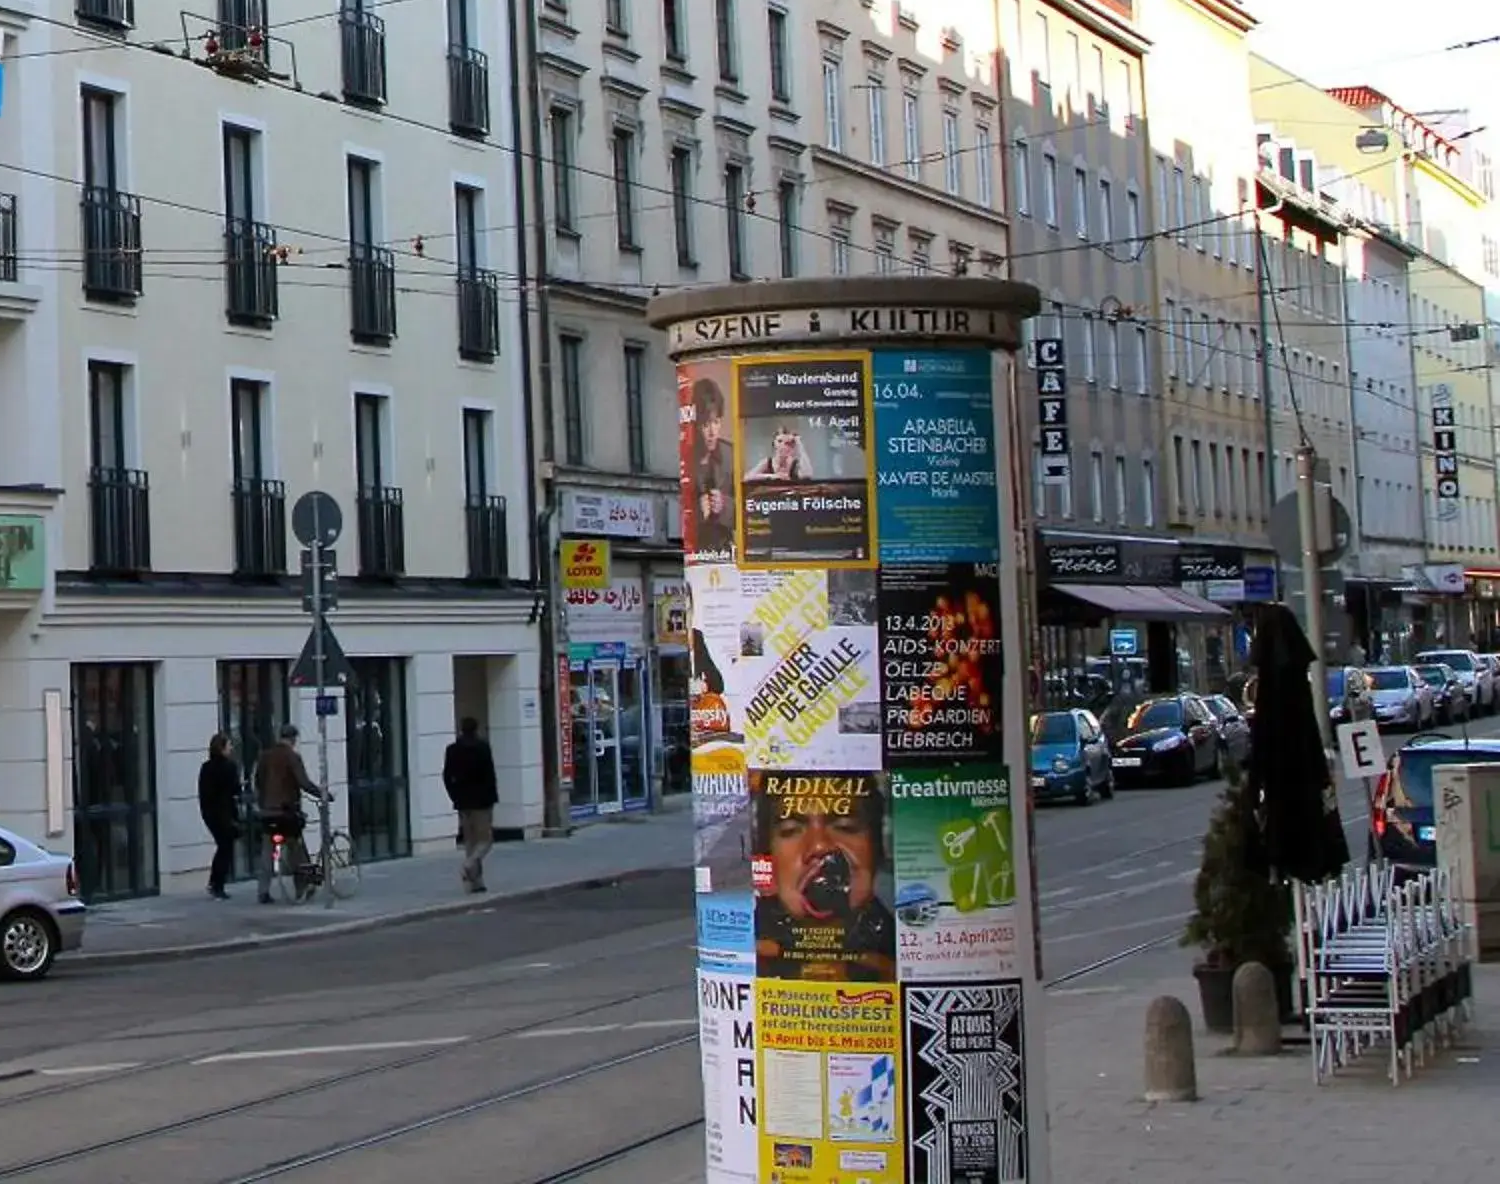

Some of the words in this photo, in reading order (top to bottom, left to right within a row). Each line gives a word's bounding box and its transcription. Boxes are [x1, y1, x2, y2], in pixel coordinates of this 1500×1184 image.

[851, 308, 971, 335] KULTUR
[873, 383, 924, 399] 16.04.
[828, 416, 860, 430] April
[903, 418, 977, 436] ARABELLA
[887, 437, 987, 454] STEINBACHER
[1434, 409, 1458, 496] KINO
[877, 471, 929, 486] XAVIER
[931, 471, 949, 486] DE
[746, 498, 799, 515] Evgenia
[803, 496, 861, 512] Fölsche
[566, 567, 603, 577] LOTTO
[885, 615, 956, 632] 13.4.2013
[883, 638, 1001, 656] AIDS-KONZERT
[885, 661, 947, 678] OELZE
[744, 641, 821, 727] ADENAUER
[777, 689, 807, 723] DE
[798, 636, 862, 702] GAULLE
[887, 730, 974, 749] LIEBREICH
[1351, 730, 1374, 769] E
[766, 777, 871, 796] RADIKAL
[891, 777, 1008, 799] creativmesse
[780, 797, 852, 819] JUNG
[899, 933, 923, 947] 12.
[934, 931, 957, 945] 14.
[959, 928, 988, 947] April
[951, 1016, 993, 1035] ATOMS
[807, 1034, 824, 1047] bis
